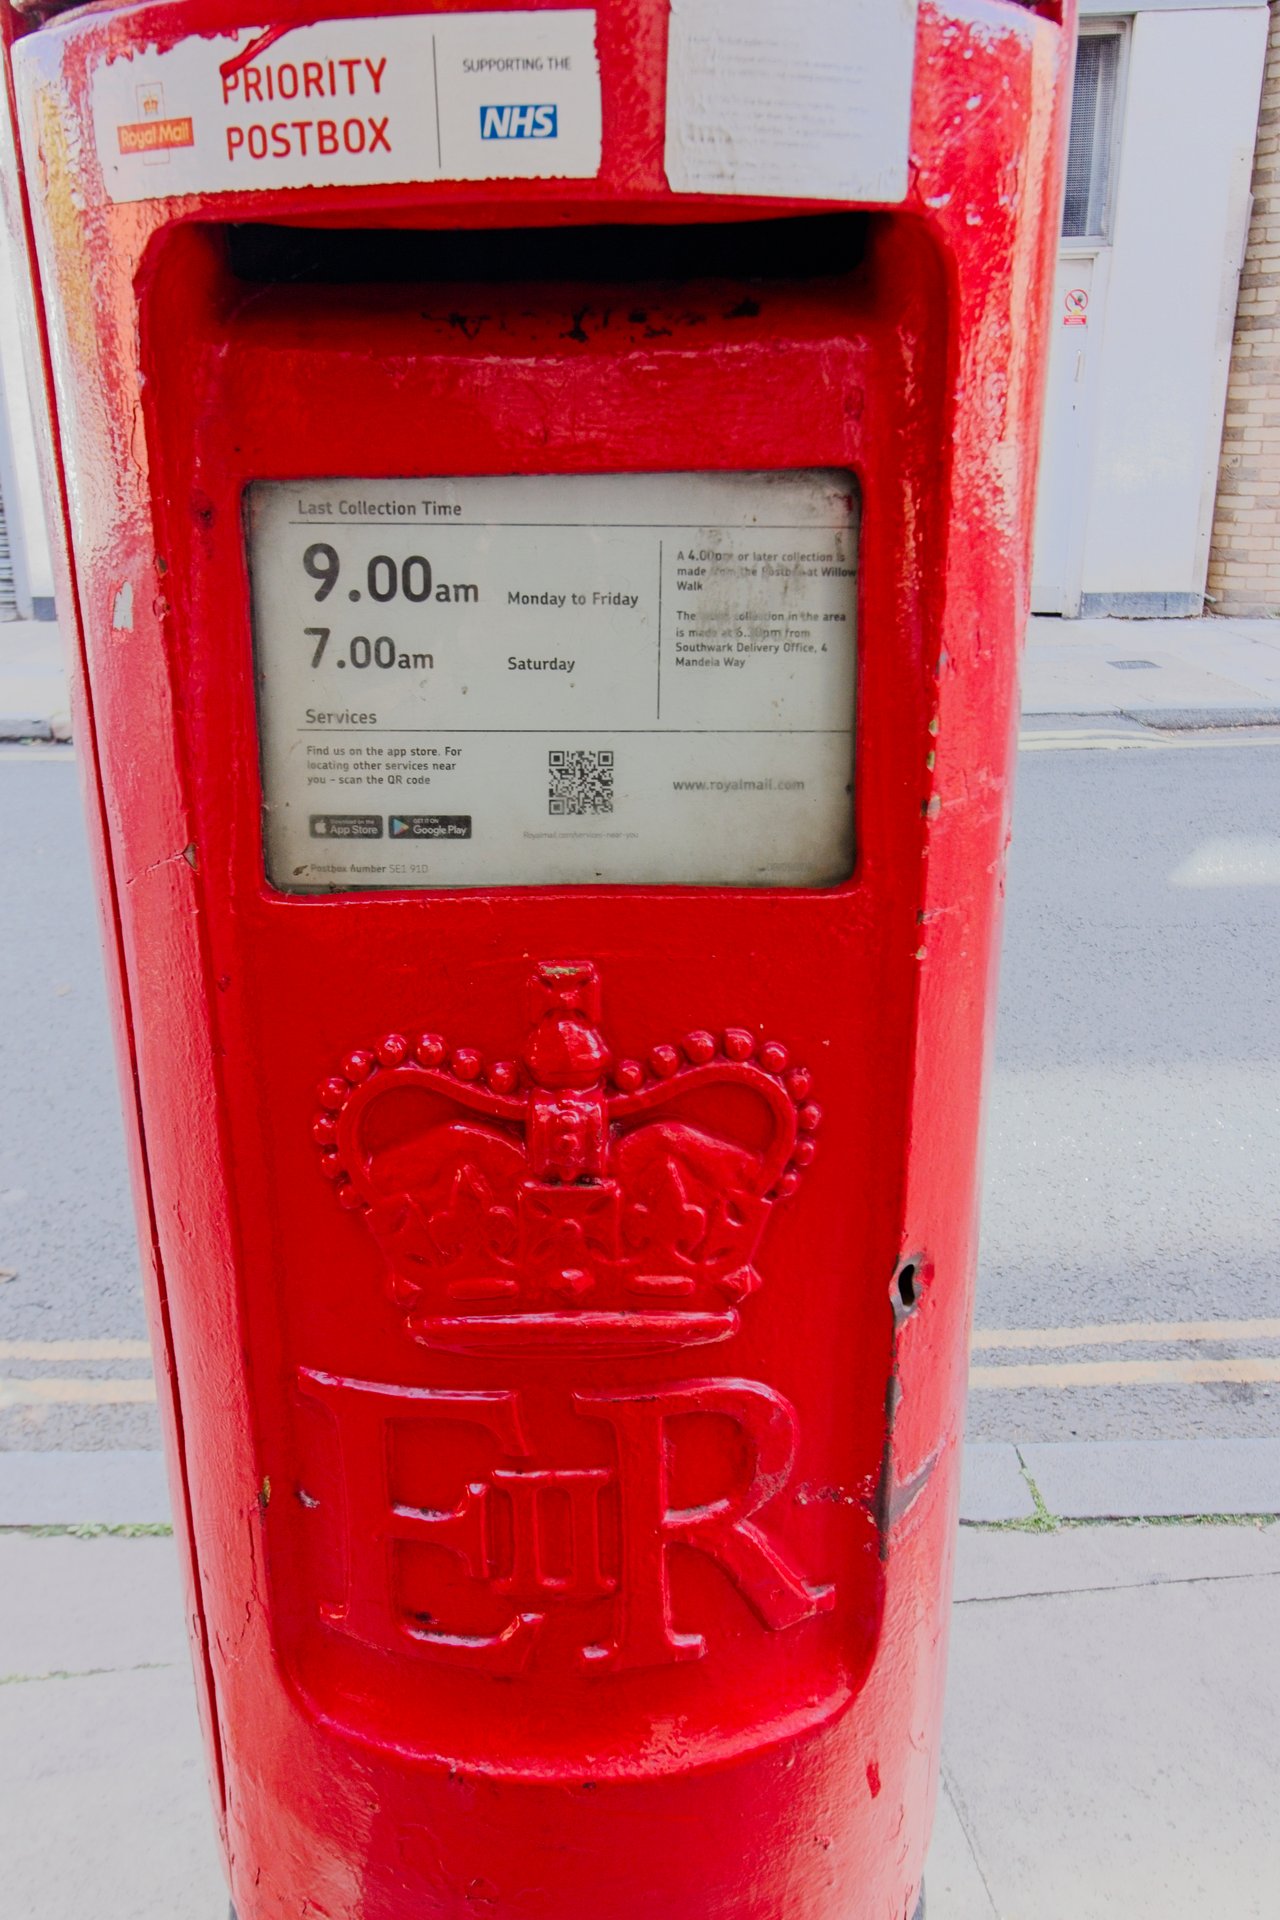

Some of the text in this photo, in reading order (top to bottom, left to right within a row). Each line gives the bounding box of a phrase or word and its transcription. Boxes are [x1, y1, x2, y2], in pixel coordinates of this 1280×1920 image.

[462, 56, 572, 73] SUPPORTING THE
[221, 57, 388, 105] PRIORITY
[482, 105, 555, 138] NHS
[120, 122, 190, 149] Royal Mail
[225, 117, 392, 162] POSTBOX
[298, 500, 462, 516] Last Collection Time
[677, 550, 685, 561] A
[737, 553, 750, 562] or
[753, 551, 778, 562] later
[781, 551, 833, 562] collection
[303, 542, 479, 603] 9.00am
[677, 566, 706, 577] made
[821, 566, 857, 577] Willow
[677, 581, 703, 591] Walk
[507, 591, 639, 608] Monday to Friday
[677, 610, 696, 621] The
[788, 611, 798, 621] in
[822, 612, 846, 622] area
[675, 628, 685, 638] is
[785, 628, 811, 638] from
[303, 627, 434, 669] 7.00am
[675, 643, 828, 654] Southwark Delivery Office, 4
[507, 656, 576, 673] Saturday
[723, 658, 746, 669] Way
[305, 709, 377, 724] Services
[306, 746, 462, 758] Find us on the app store. For
[307, 761, 456, 772] locating other services near
[307, 776, 326, 786] you
[339, 776, 362, 785] scan
[366, 775, 384, 785] the
[387, 775, 403, 785] QR
[406, 776, 431, 785] code
[672, 779, 806, 793] www.royalmail.com
[330, 824, 379, 836] App Store
[413, 824, 468, 837] Google Play
[310, 864, 348, 874] Postbox
